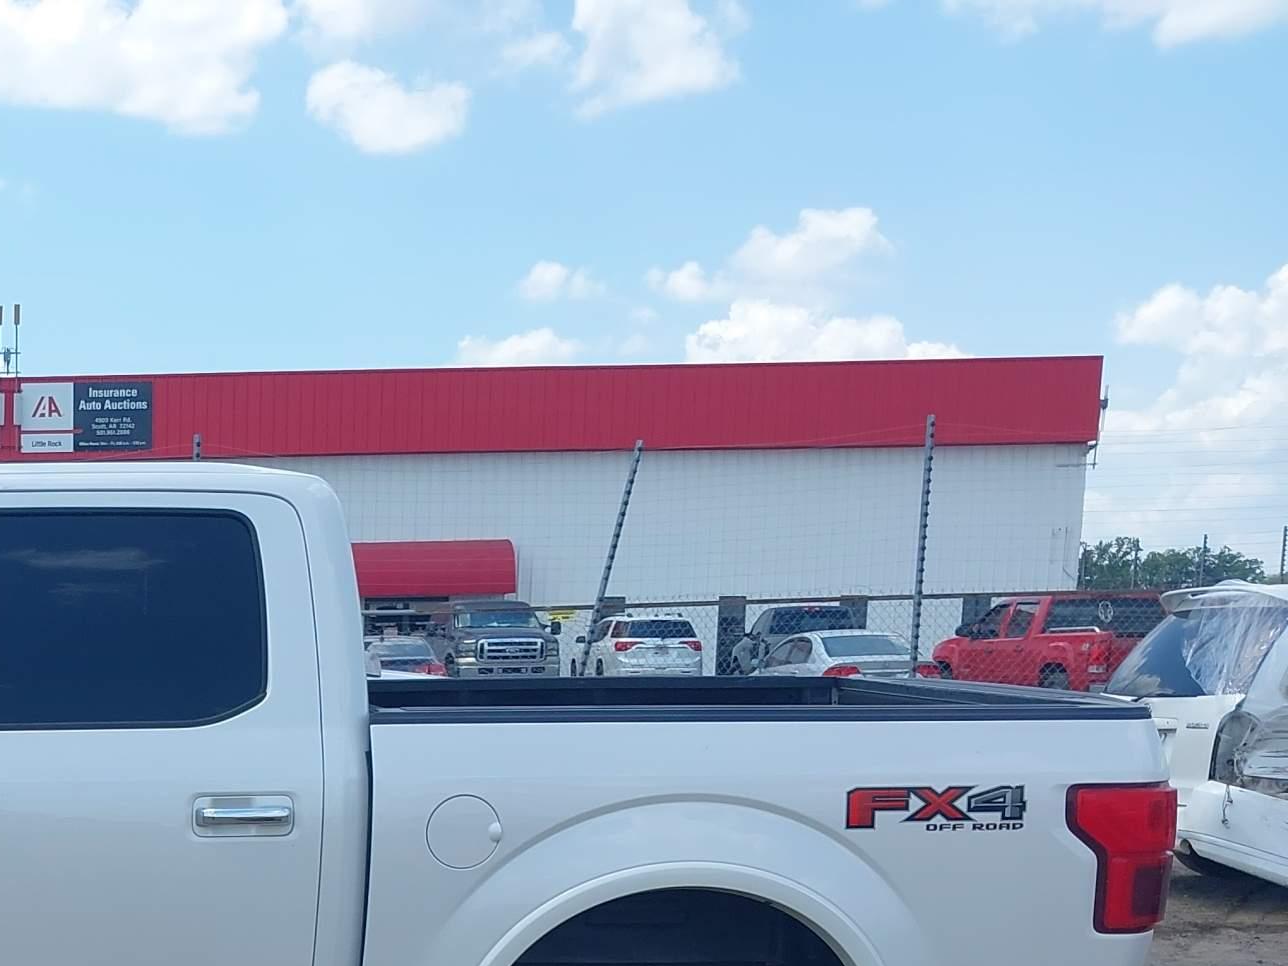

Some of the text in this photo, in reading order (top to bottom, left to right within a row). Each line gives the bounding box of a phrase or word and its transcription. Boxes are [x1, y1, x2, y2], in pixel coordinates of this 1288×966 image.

[88, 387, 138, 398] Insurance
[78, 399, 148, 410] Auto Auctions
[845, 785, 1027, 830] FX4
[925, 822, 1025, 832] OFF ROAD
